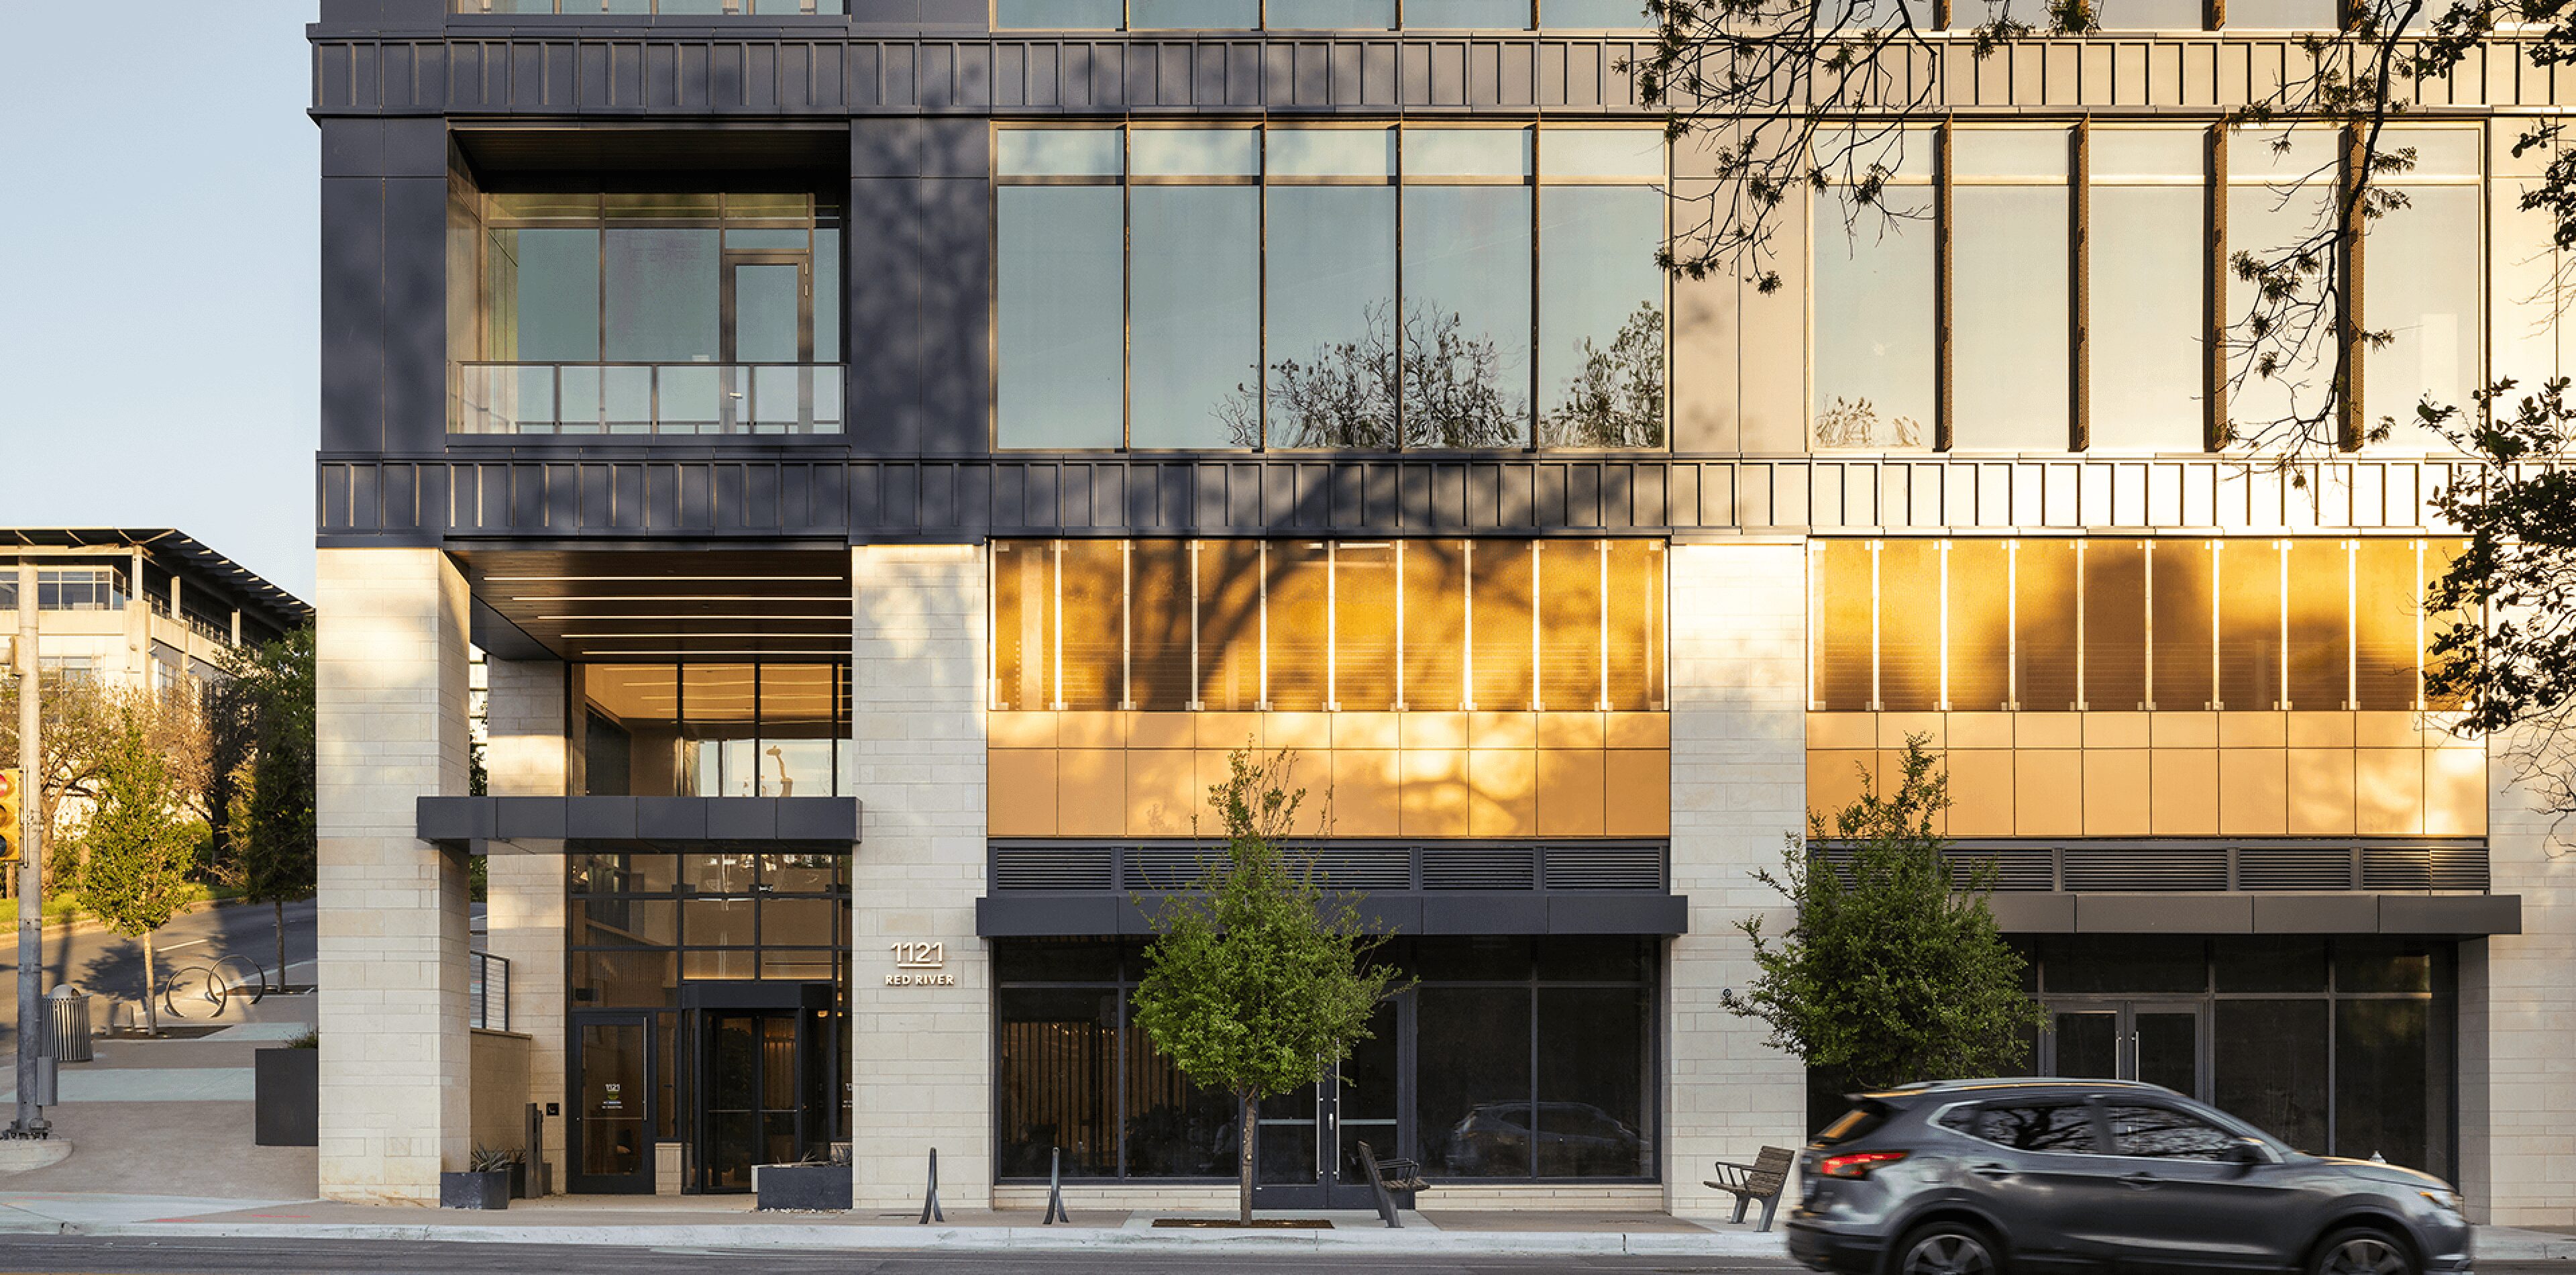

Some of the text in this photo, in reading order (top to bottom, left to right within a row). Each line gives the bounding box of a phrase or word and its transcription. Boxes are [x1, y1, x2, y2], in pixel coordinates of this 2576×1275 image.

[891, 942, 943, 962] 1121
[885, 974, 955, 986] RED RIVER
